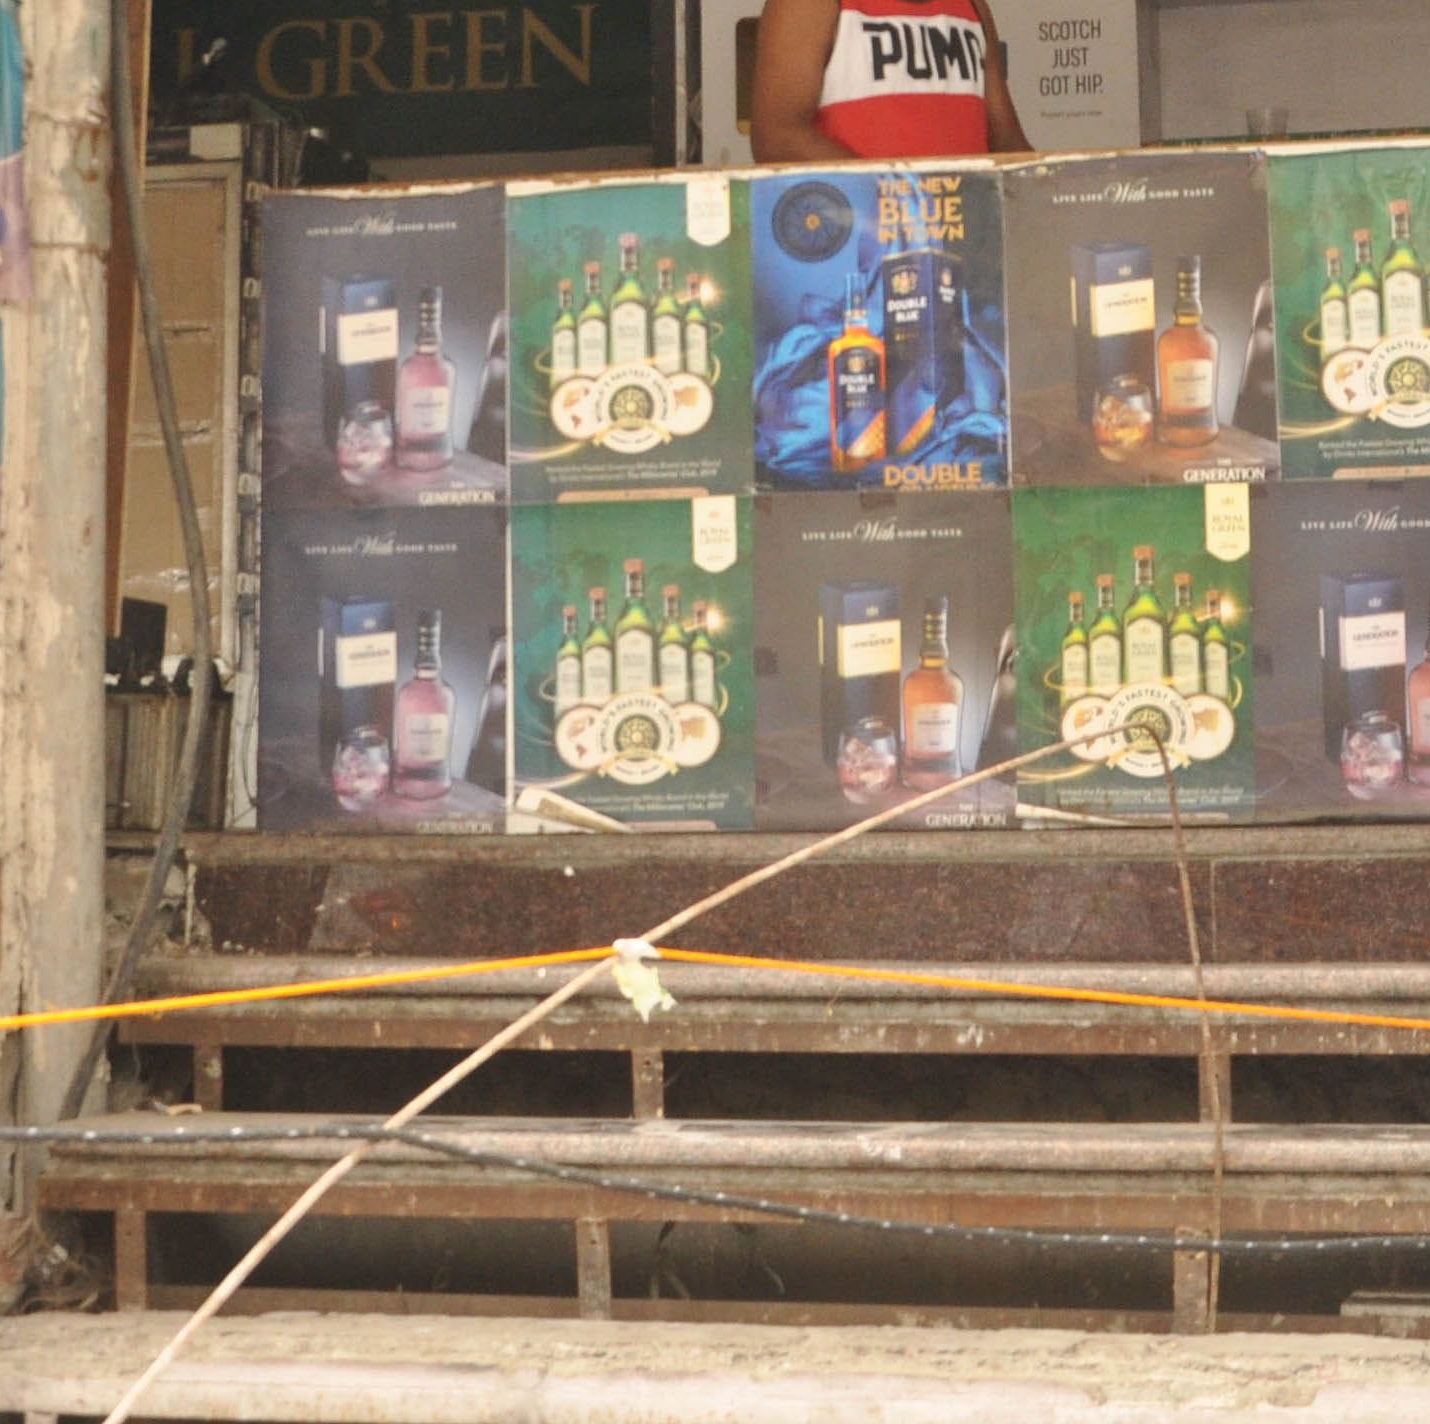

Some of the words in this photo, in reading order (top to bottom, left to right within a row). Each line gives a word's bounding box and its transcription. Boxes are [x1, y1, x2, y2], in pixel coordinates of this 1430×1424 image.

[1038, 18, 1101, 42] SCOTCH
[255, 2, 600, 101] GREEN
[1052, 47, 1089, 69] JUST
[1039, 75, 1069, 96] GOT
[918, 175, 962, 193] NEW
[879, 196, 963, 225] BLUE
[884, 463, 982, 487] DOUBLE
[1183, 465, 1266, 483] GENERATION
[1355, 505, 1400, 532] With
